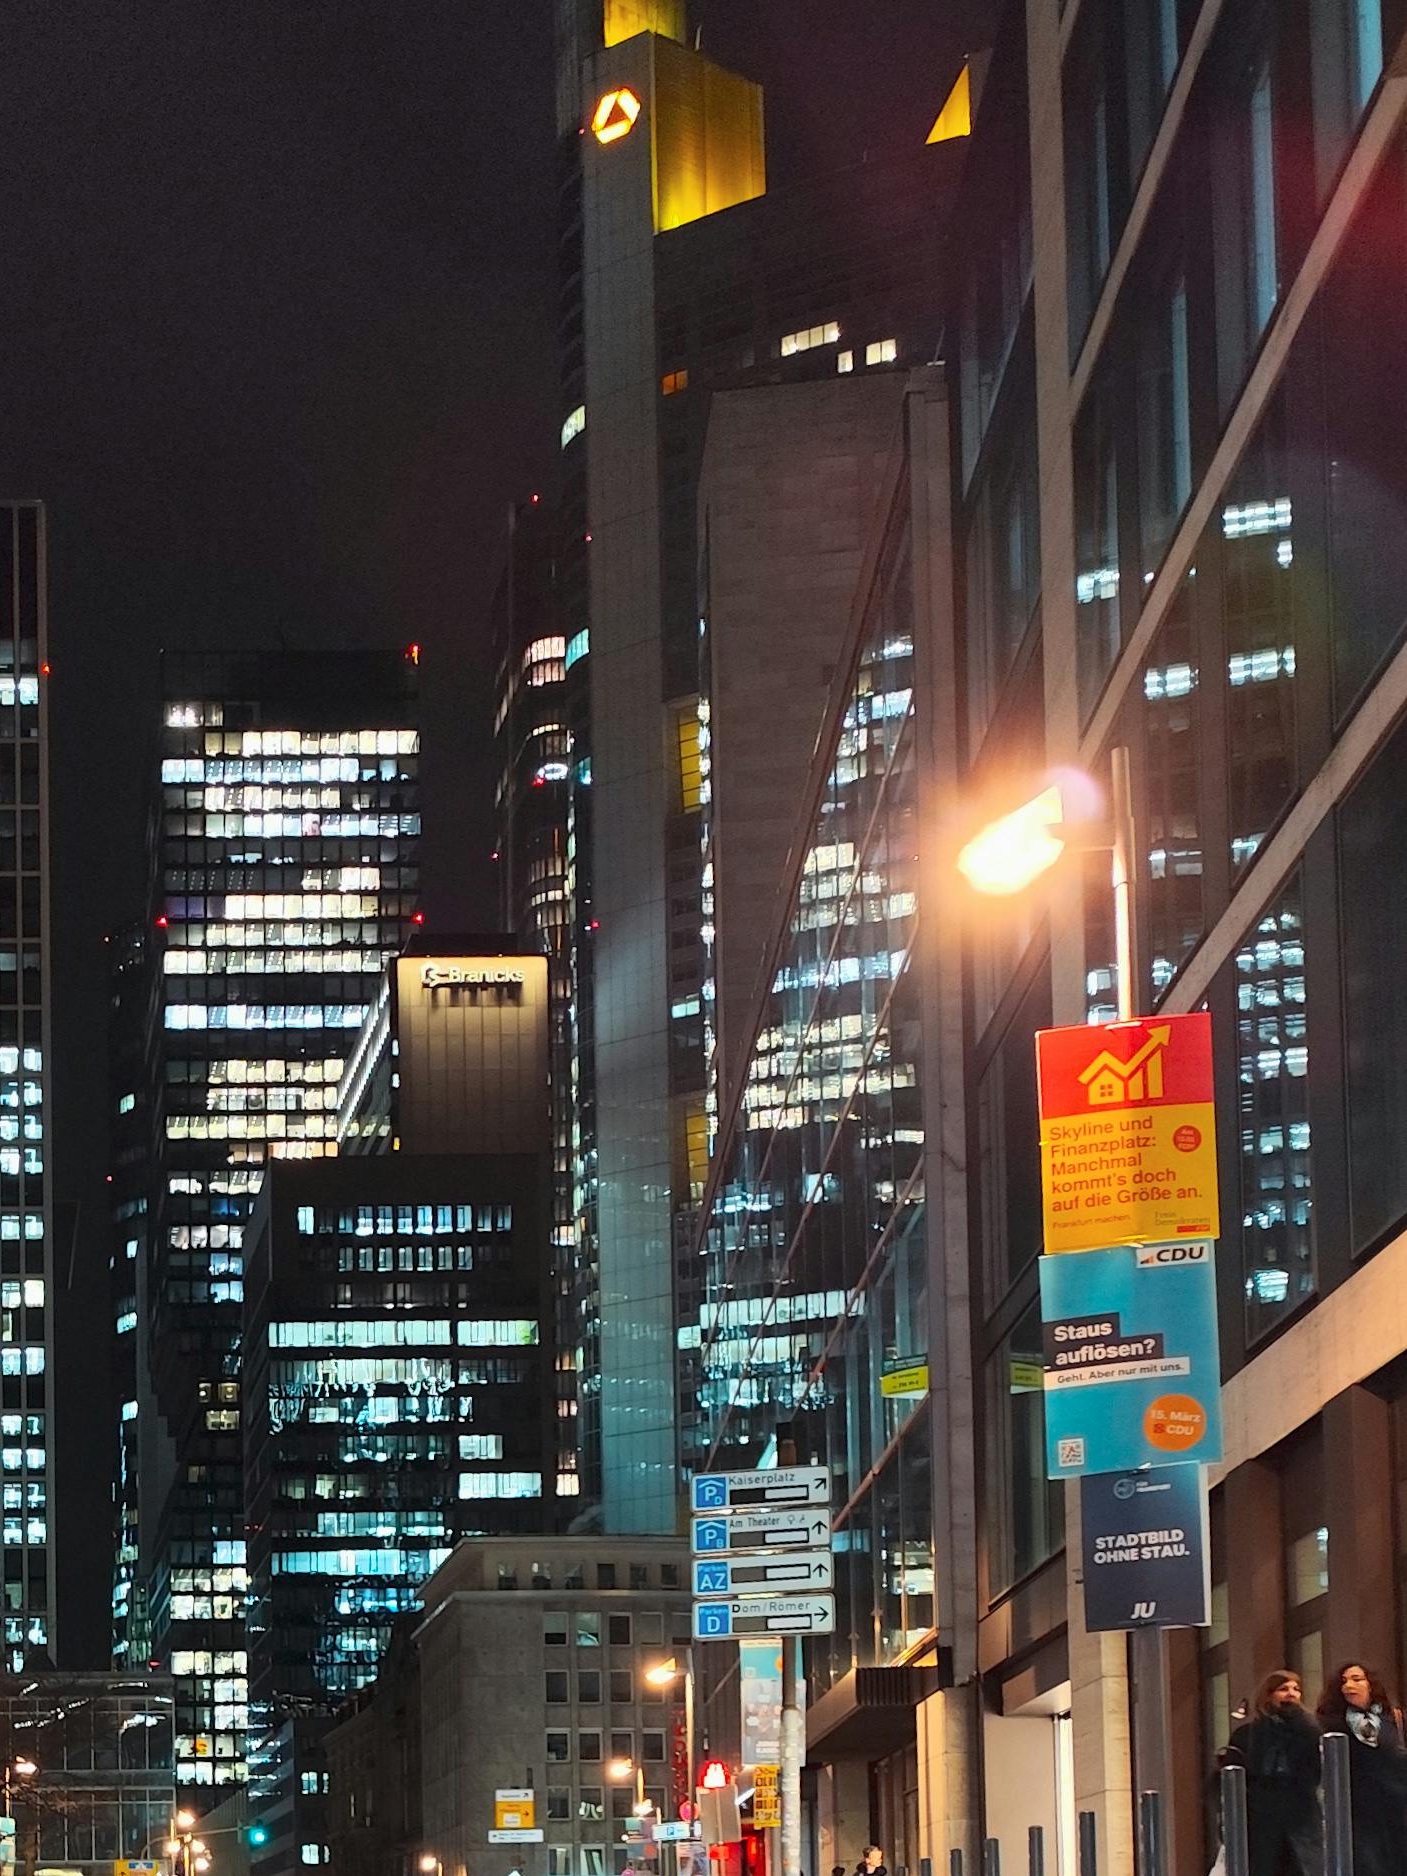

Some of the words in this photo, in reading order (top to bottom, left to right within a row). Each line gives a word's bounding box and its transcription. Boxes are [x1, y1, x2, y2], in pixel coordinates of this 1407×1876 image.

[449, 967, 525, 983] Branicks
[1049, 1123, 1114, 1141] Skyline
[1120, 1116, 1153, 1131] und
[1051, 1135, 1157, 1158] Finanzplatz:
[1051, 1153, 1142, 1176] Manchmal
[1051, 1173, 1127, 1194] kommt's
[1132, 1168, 1176, 1185] doch
[1052, 1194, 1080, 1212] auf
[1085, 1191, 1111, 1207] die
[1117, 1186, 1171, 1204] Größe
[1177, 1186, 1203, 1200] an.
[1156, 1246, 1204, 1262] CDU
[1054, 1322, 1112, 1342] Staus
[1055, 1338, 1156, 1365] auflösen?
[1057, 1371, 1087, 1383] Geht.
[1089, 1368, 1115, 1380] Aber
[1117, 1367, 1137, 1376] nur
[1139, 1363, 1158, 1374] mit
[1160, 1363, 1185, 1373] uns.
[1150, 1409, 1167, 1420] 15.
[1170, 1411, 1202, 1423] März
[1166, 1424, 1195, 1436] CDU
[729, 1472, 795, 1486] Kaiserplatz
[729, 1519, 743, 1528] Am
[747, 1516, 780, 1526] Theater
[1095, 1528, 1184, 1549] STADTBILD
[1094, 1548, 1140, 1564] OHNE
[1141, 1544, 1190, 1560] STAU.
[700, 1573, 726, 1590] AZ
[1130, 1602, 1156, 1619] JU
[707, 1616, 720, 1633] D
